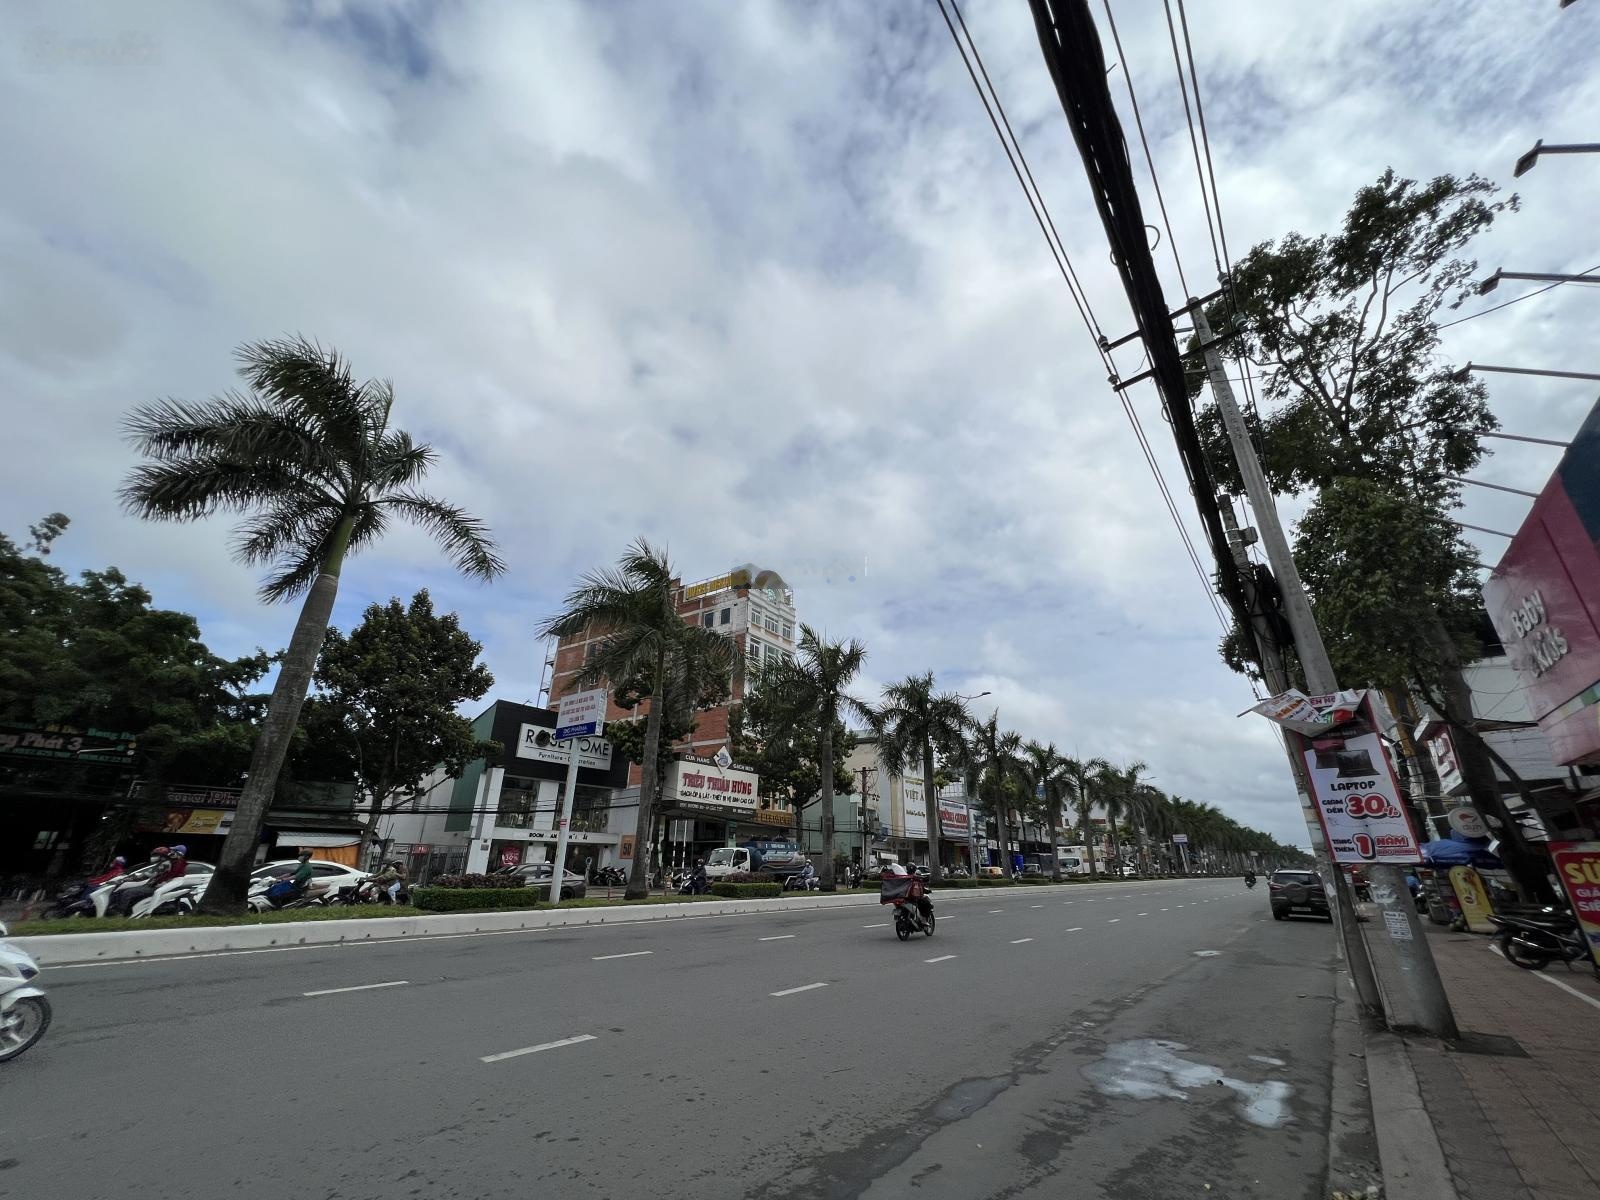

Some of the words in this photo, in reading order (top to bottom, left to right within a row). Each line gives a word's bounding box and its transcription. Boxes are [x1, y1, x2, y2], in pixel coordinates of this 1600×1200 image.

[1510, 589, 1546, 639] Baby
[67, 737, 83, 751] 3
[538, 751, 563, 762] Furniture
[1330, 780, 1376, 792] LAPTOP
[1345, 793, 1401, 819] 30%
[1352, 833, 1376, 860] 1
